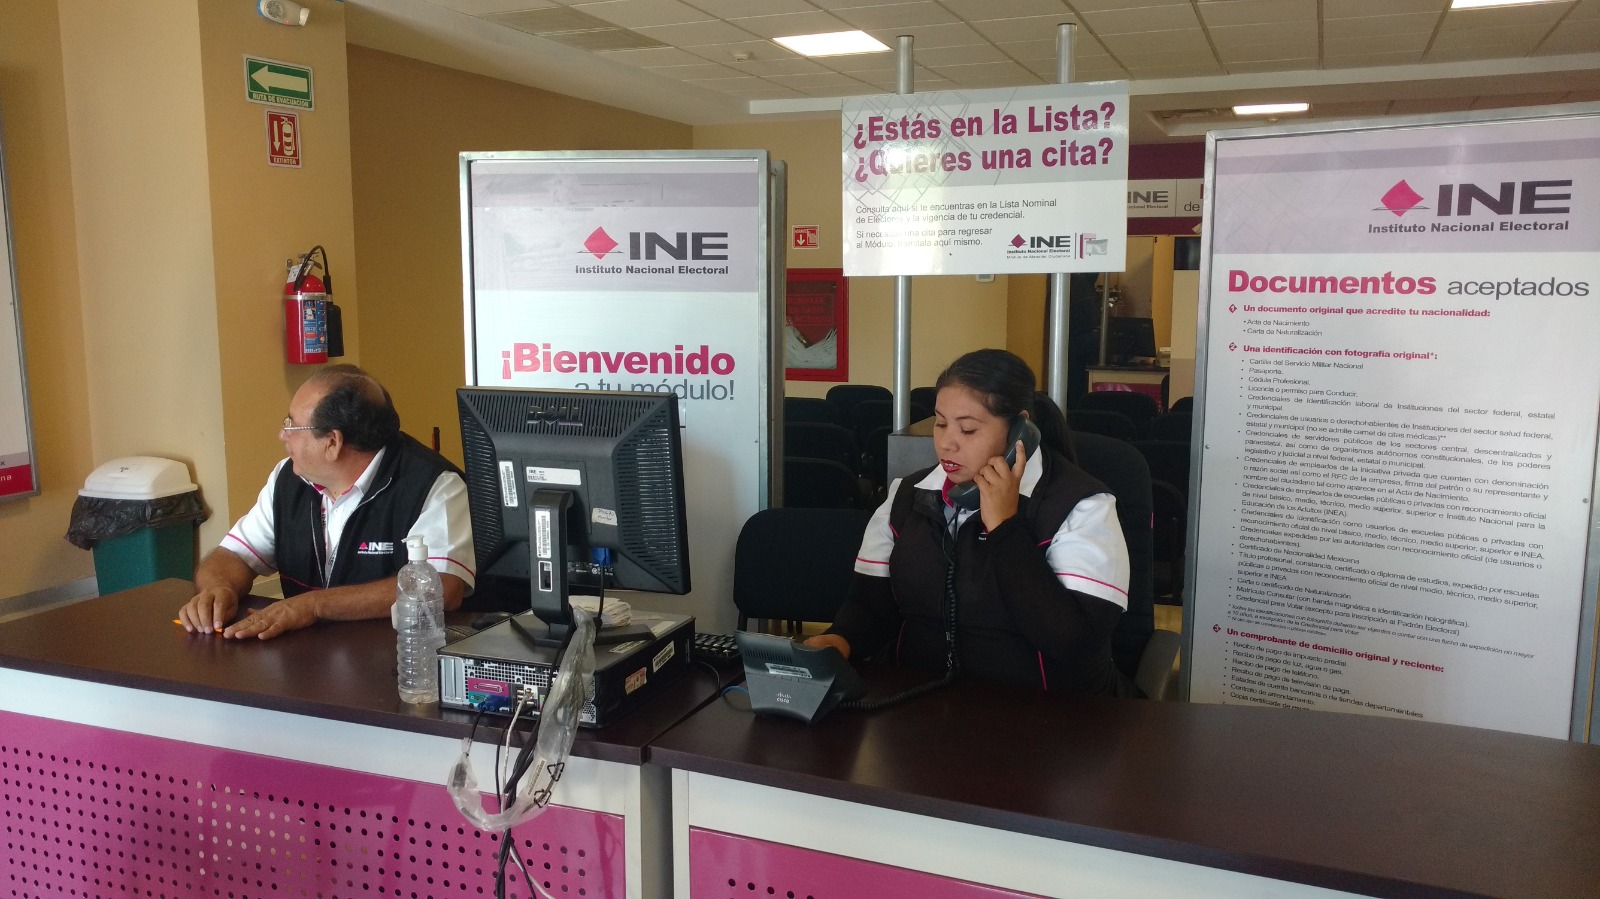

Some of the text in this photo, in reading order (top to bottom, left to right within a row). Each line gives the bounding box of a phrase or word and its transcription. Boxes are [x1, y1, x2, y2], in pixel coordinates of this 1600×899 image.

[253, 93, 267, 101] RUTA
[853, 102, 1115, 150] ¿Estás en la Lista?
[854, 137, 1114, 182] ¿Quieres una cita?
[1437, 180, 1573, 217] INE
[856, 205, 889, 214] Consulta
[892, 204, 909, 214] aquí
[930, 202, 974, 210] encuentras
[1000, 200, 1019, 208] Lista
[1022, 198, 1056, 207] Nominal
[1184, 202, 1200, 212] de
[922, 213, 954, 223] vigencia
[957, 212, 967, 220] de
[970, 212, 977, 220] tu
[980, 211, 1024, 219] credencial.
[857, 230, 863, 238] Si
[938, 229, 956, 237] para
[958, 228, 992, 236] regresar
[1368, 220, 1569, 234] Instituto Nacional Electoral
[629, 232, 728, 261] INE
[856, 240, 862, 248] al
[934, 238, 951, 247] aquí
[954, 238, 982, 246] mismo.
[1030, 236, 1070, 248] INE
[576, 265, 729, 275] Instituto Nacional Electoral
[1228, 270, 1590, 300] Documentos aceptados
[1258, 305, 1307, 313] documento
[1309, 306, 1343, 315] original
[1409, 308, 1420, 316] tu
[1422, 308, 1491, 318] nacionalidad:
[1276, 328, 1322, 336] Naturalización
[1263, 345, 1322, 355] identificación
[1325, 348, 1342, 356] con
[1344, 348, 1390, 358] fotografía
[502, 342, 736, 380] ¡Bienvenido
[1333, 362, 1364, 370] Nacional
[1249, 367, 1283, 375] Pasaporte.
[1248, 394, 1290, 402] Credenciales
[1307, 398, 1351, 406] identificación
[1253, 403, 1282, 411] municipal
[1247, 412, 1288, 420] Credenciales
[1337, 417, 1399, 428] derechohabientes
[1274, 423, 1304, 431] municipal
[369, 542, 393, 550] INE
[1239, 542, 1272, 552] Certificado
[1284, 548, 1325, 560] Nacionalidad
[1327, 554, 1360, 564] Mexicana
[1261, 581, 1293, 591] certificado
[1305, 587, 1352, 599] Naturalización
[1240, 631, 1296, 646] comprobante
[1312, 644, 1353, 656] domicilio
[1355, 652, 1390, 662] original
[1400, 660, 1444, 672] reciente:
